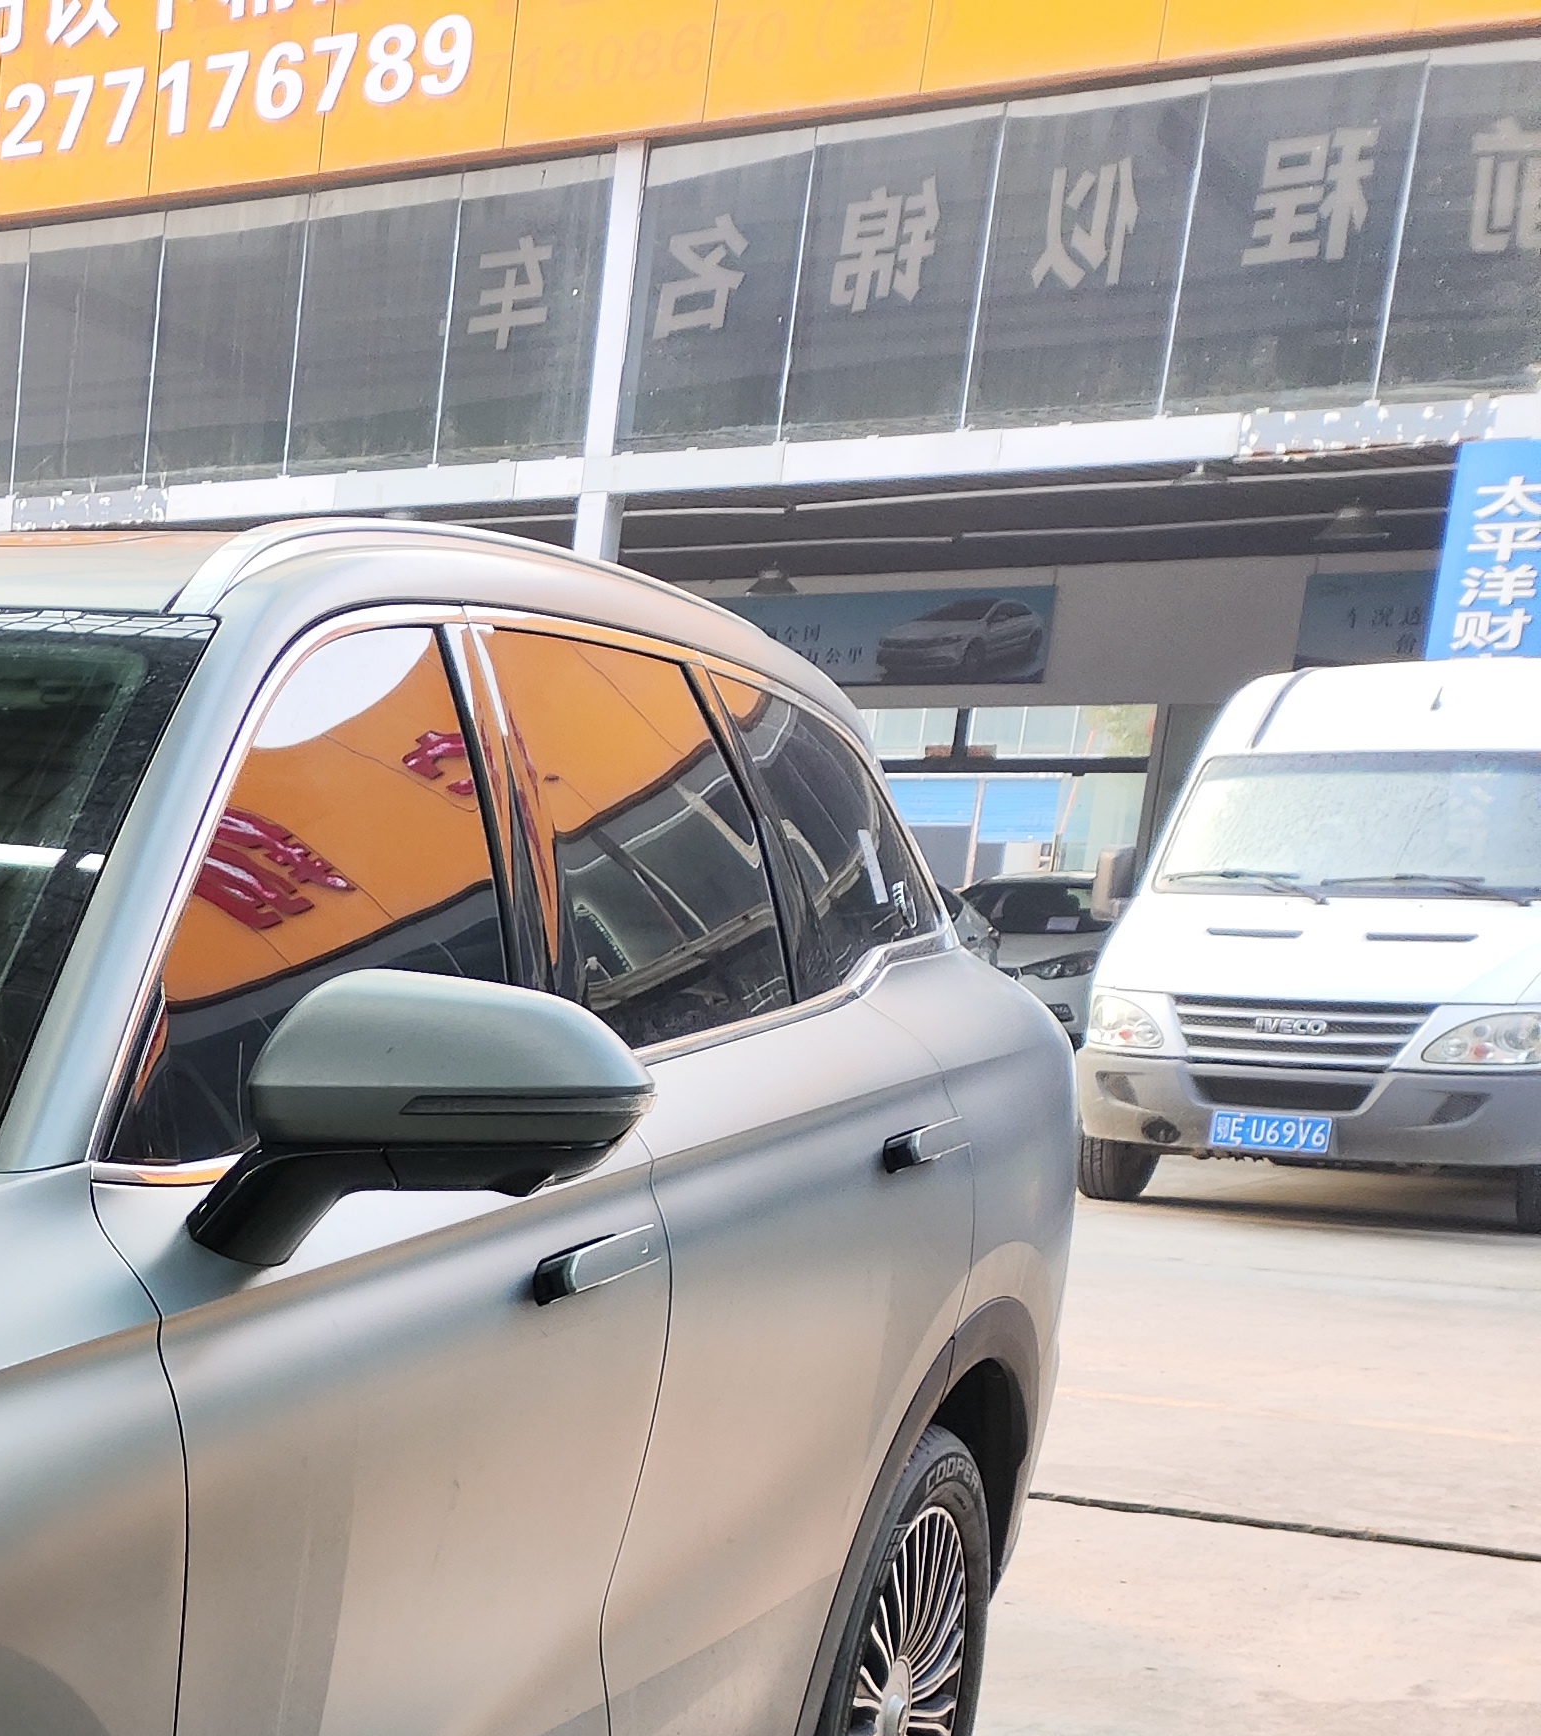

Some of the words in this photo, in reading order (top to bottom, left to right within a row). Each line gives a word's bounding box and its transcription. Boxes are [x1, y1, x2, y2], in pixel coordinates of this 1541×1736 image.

[1449, 475, 1541, 658] 太平洋财
[1255, 1017, 1328, 1035] IVECO
[925, 1457, 980, 1495] COOPER
